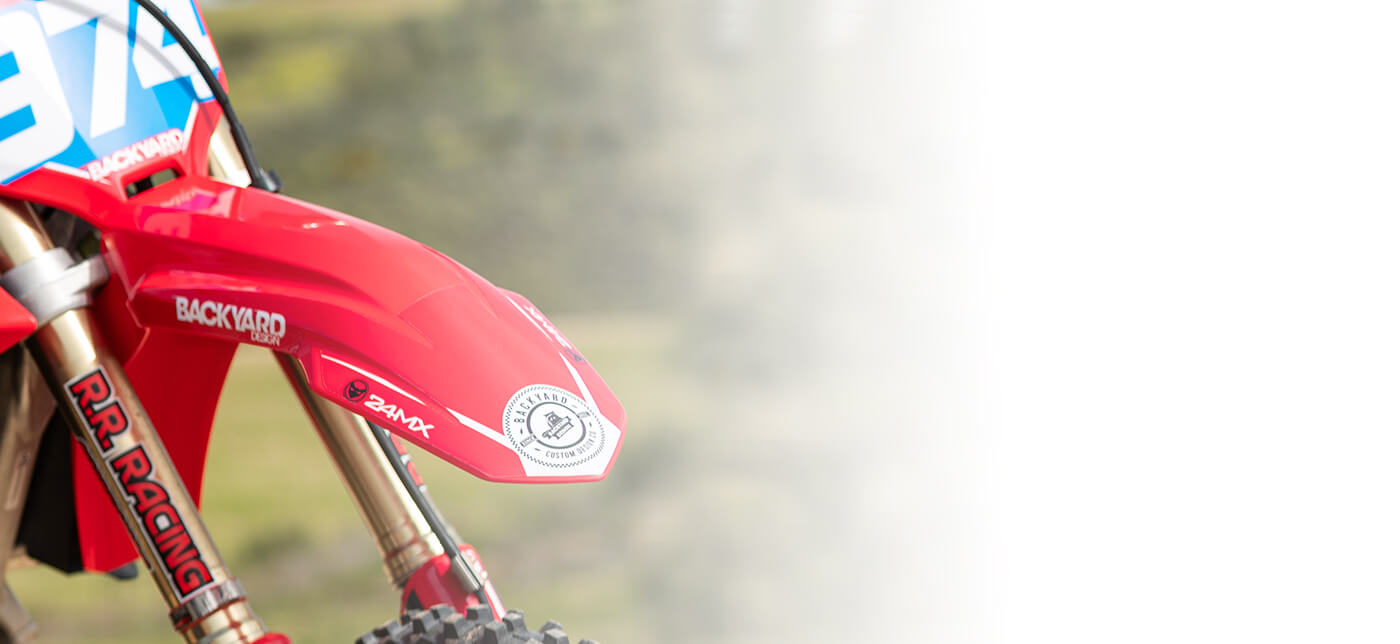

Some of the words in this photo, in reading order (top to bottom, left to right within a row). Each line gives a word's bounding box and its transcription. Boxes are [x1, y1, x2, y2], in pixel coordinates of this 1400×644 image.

[88, 128, 183, 181] BACKYARD
[175, 297, 286, 338] BACKYARD
[251, 331, 281, 347] DESIGN
[364, 393, 435, 439] 24MX
[514, 392, 568, 423] BACKYARD
[546, 450, 576, 460] CUSTOM
[109, 444, 215, 598] RACING
